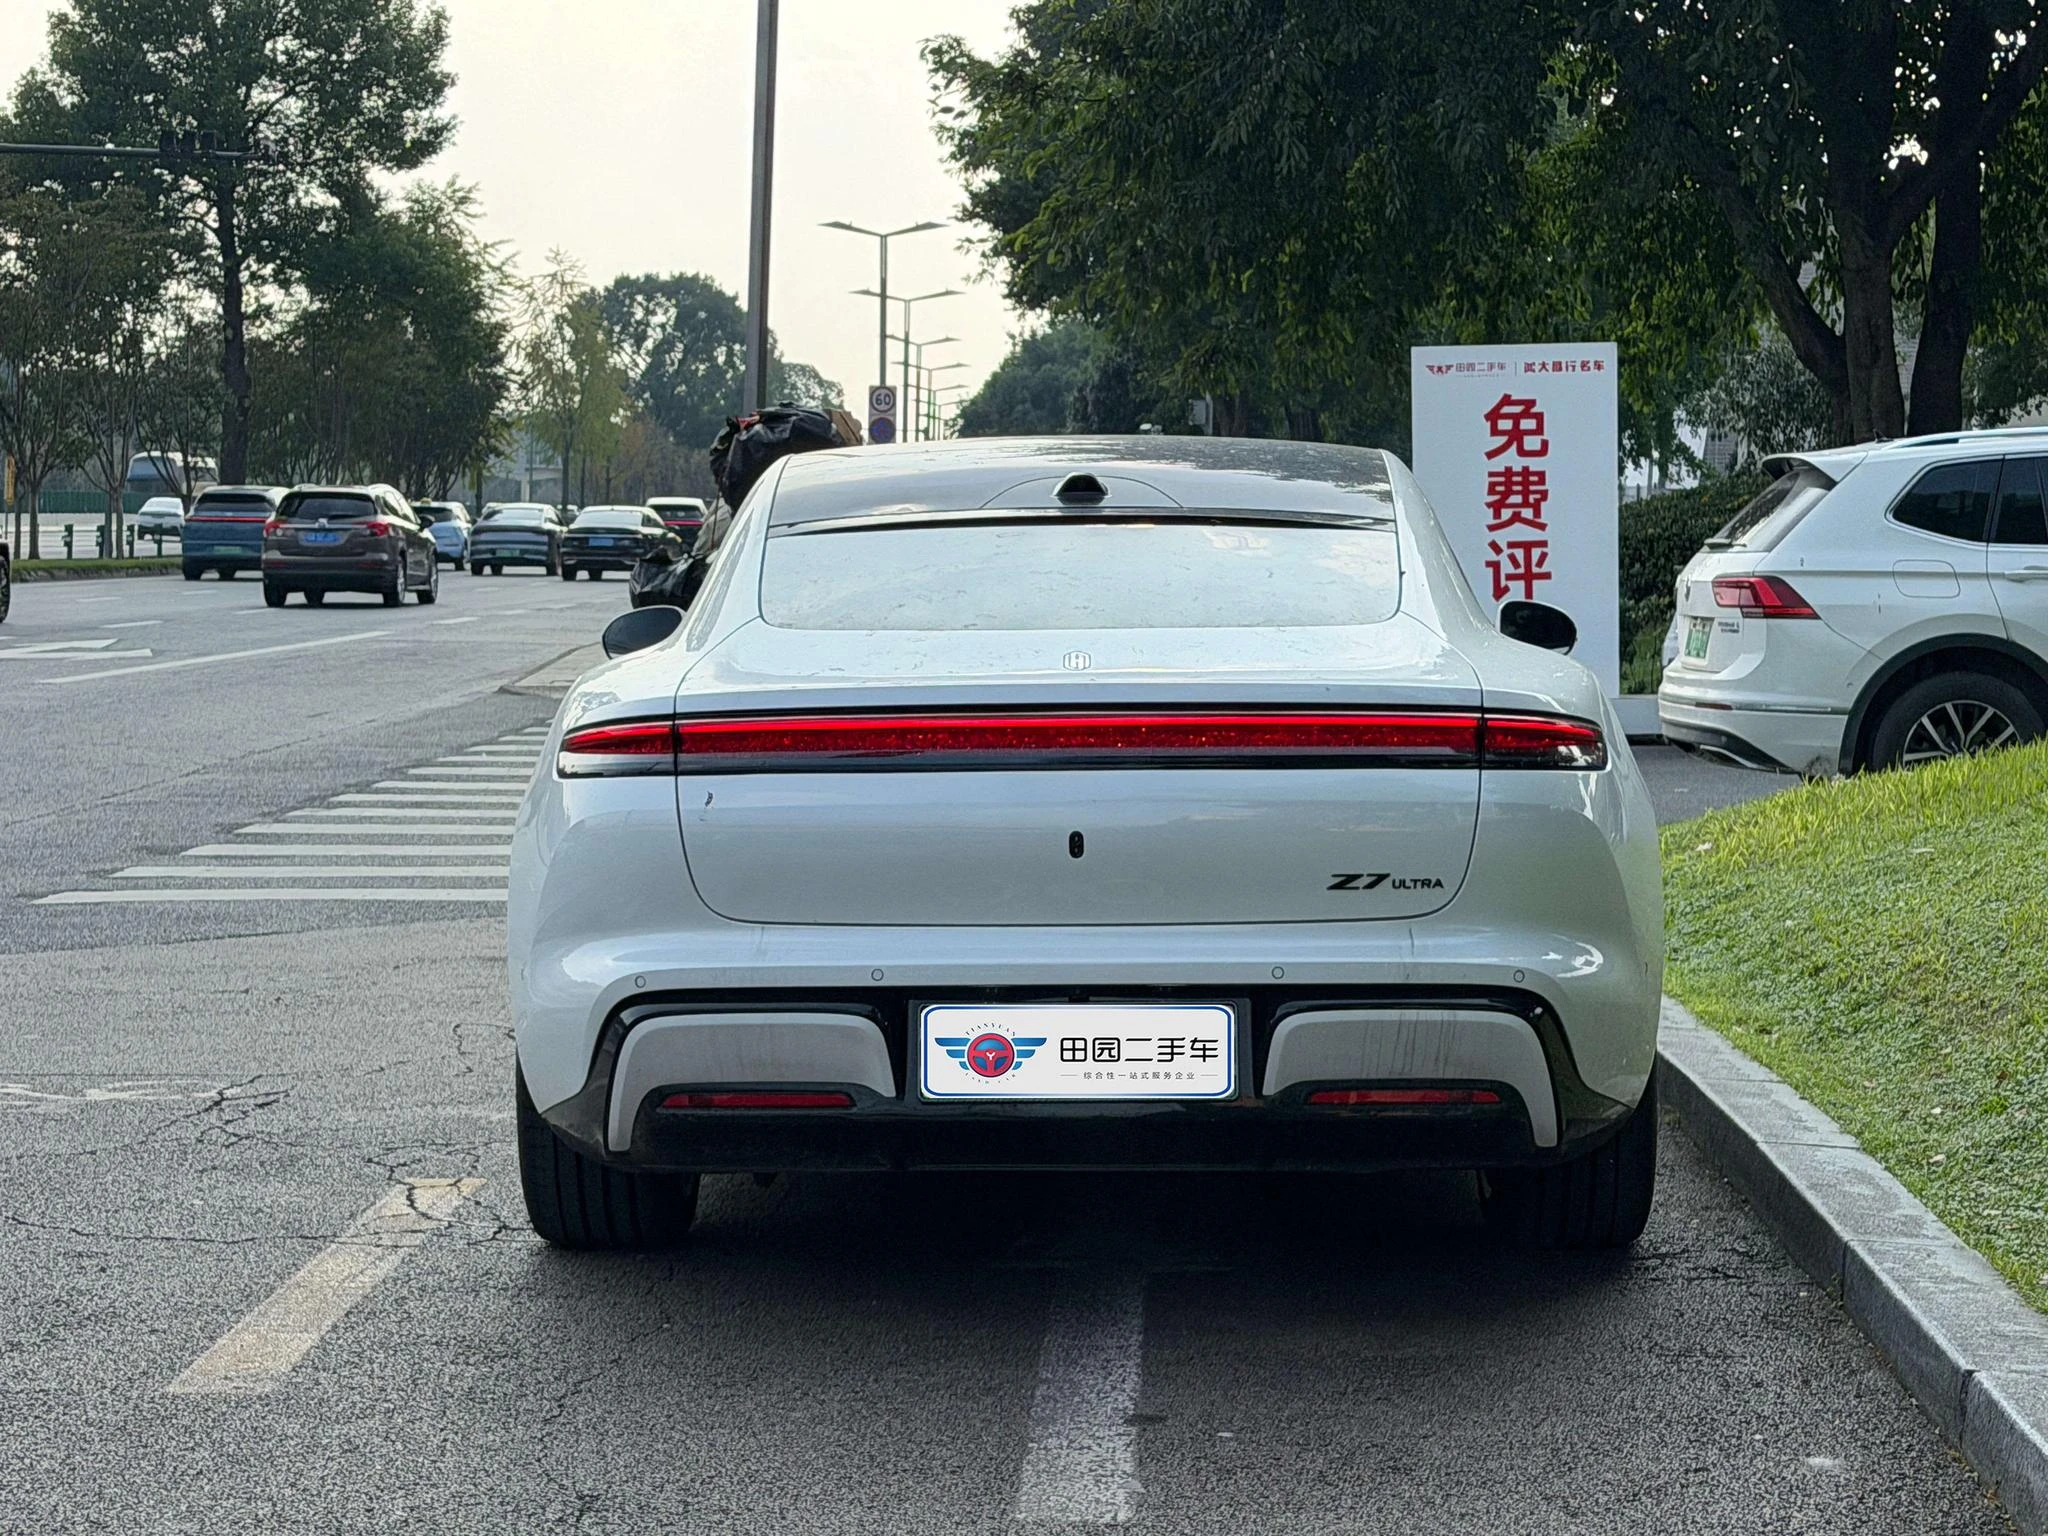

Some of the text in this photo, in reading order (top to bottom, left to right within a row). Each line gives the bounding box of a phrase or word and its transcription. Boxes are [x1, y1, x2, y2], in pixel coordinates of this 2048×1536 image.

[875, 393, 892, 406] 60
[1326, 872, 1444, 891] Z7 ULTRA
[1059, 1036, 1219, 1063] 田园二手车
[1083, 1071, 1196, 1080] 综合性一站式服务企业
